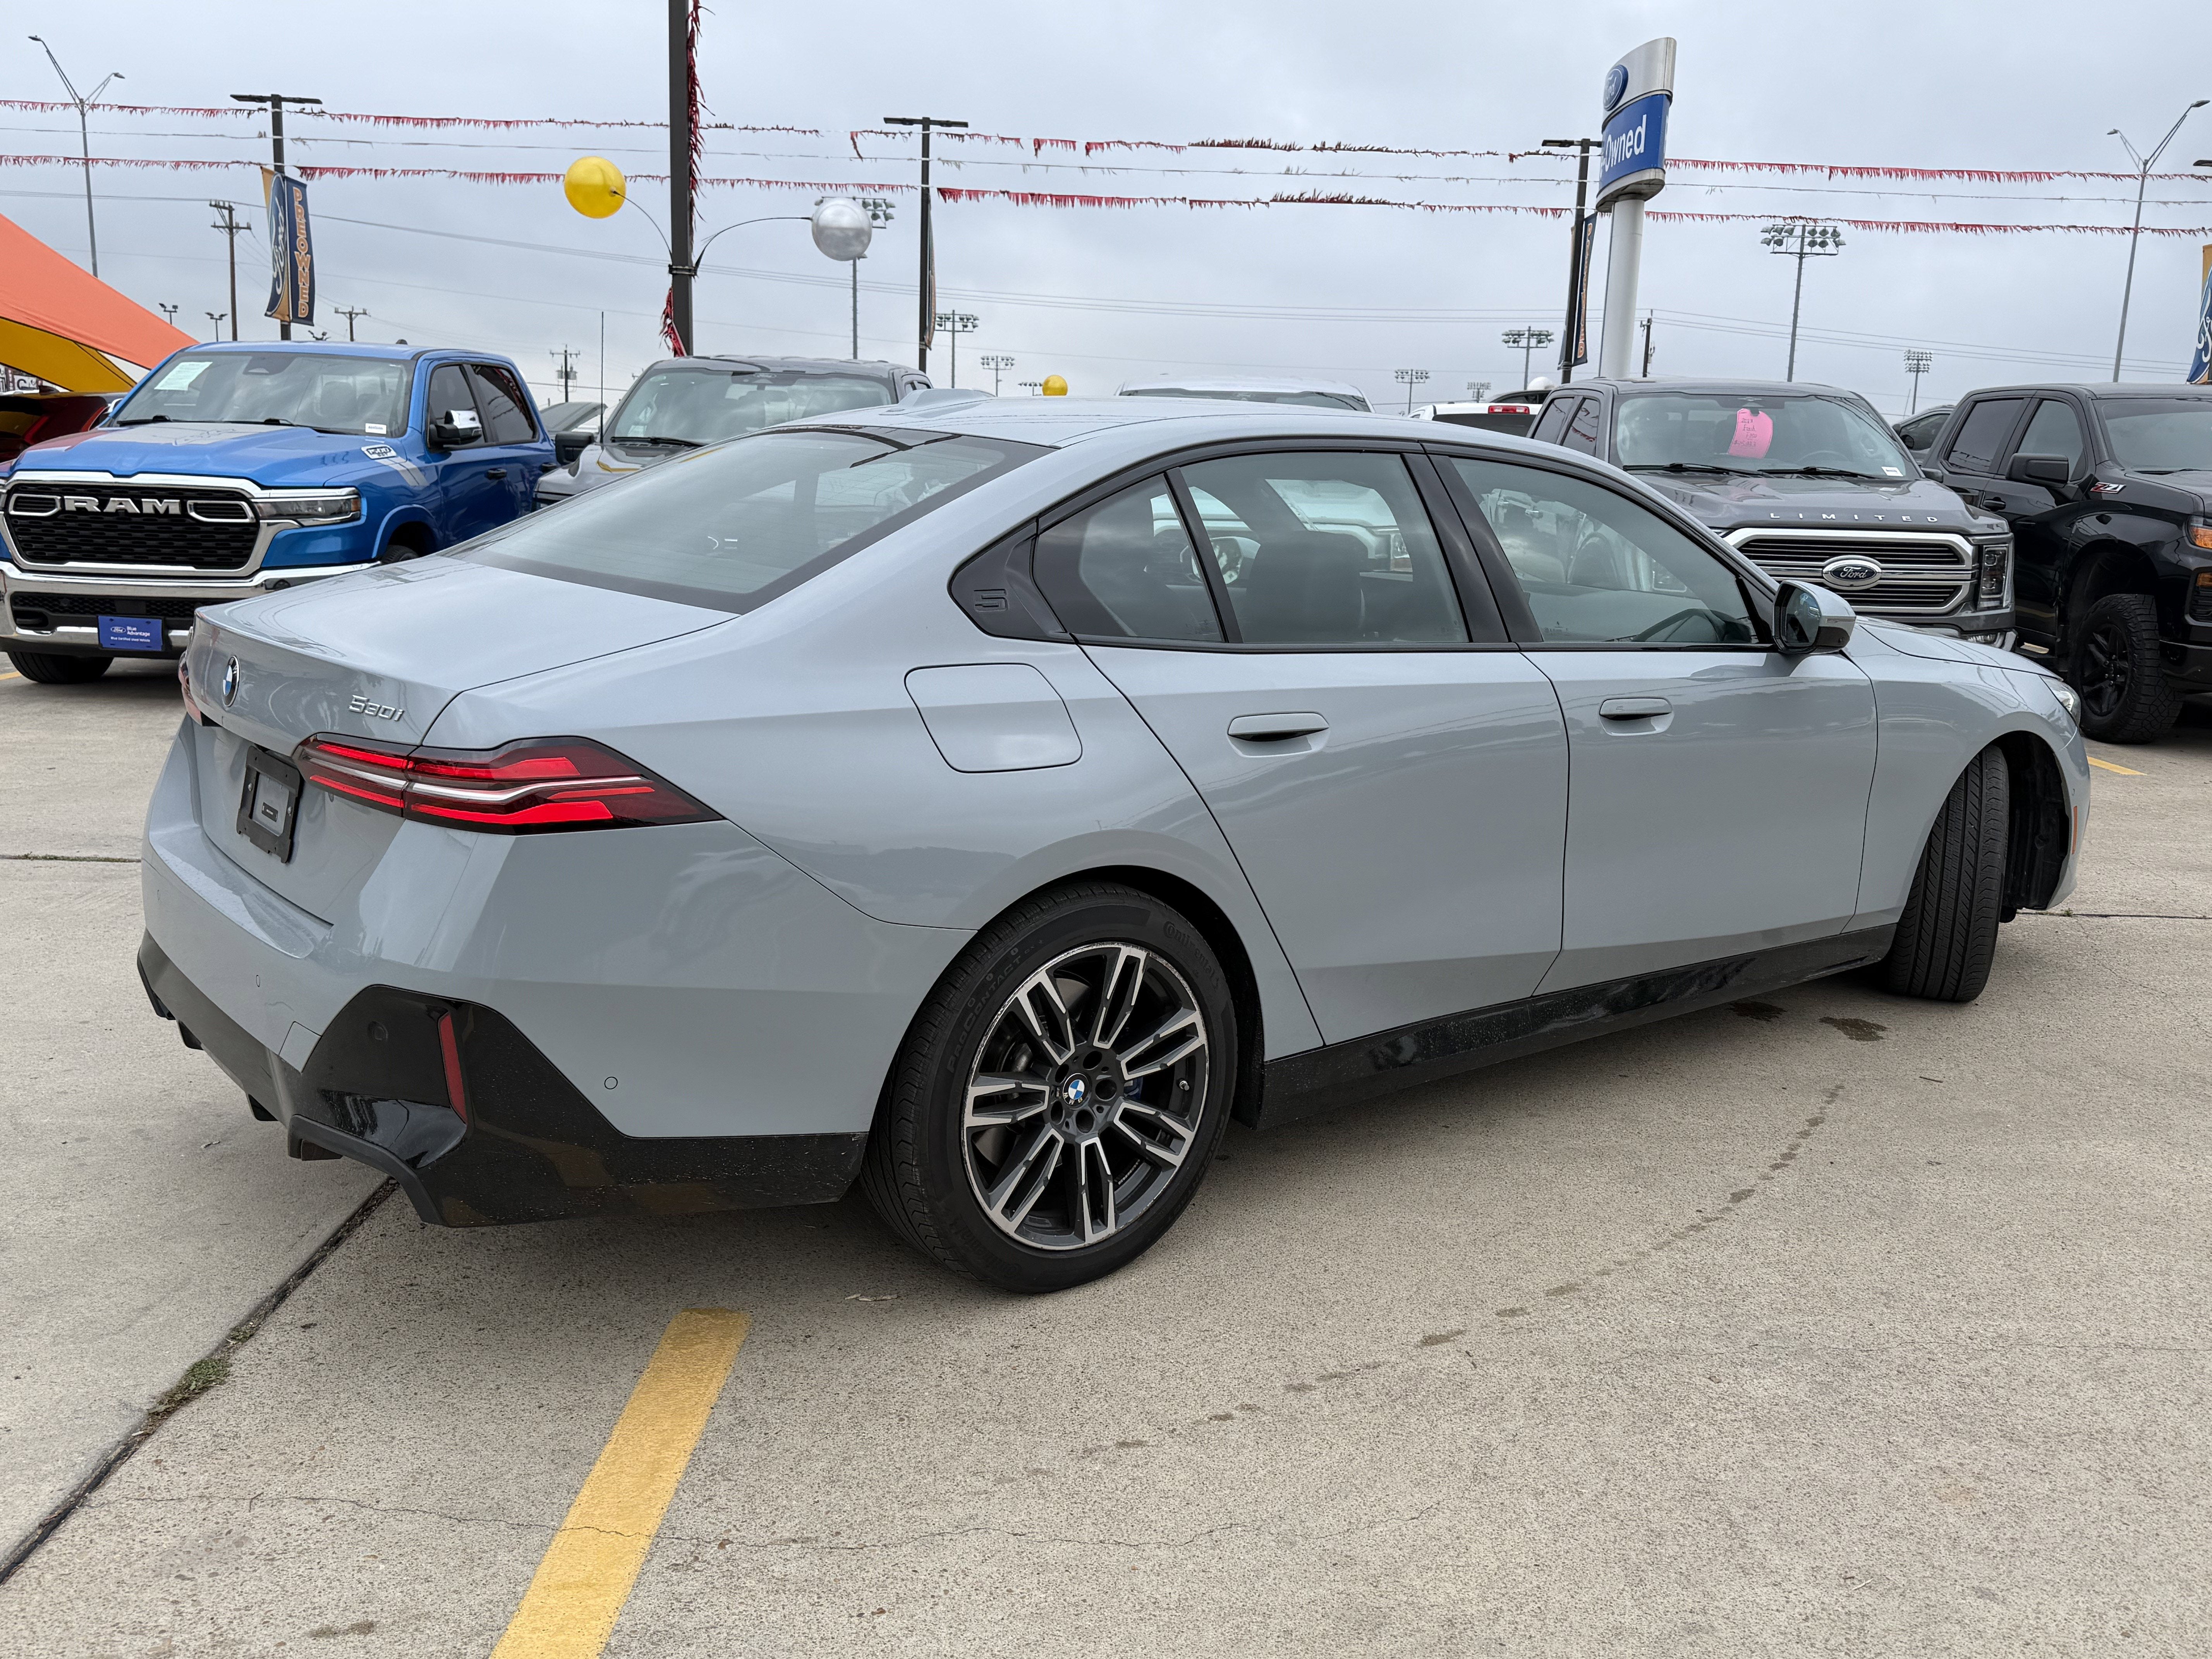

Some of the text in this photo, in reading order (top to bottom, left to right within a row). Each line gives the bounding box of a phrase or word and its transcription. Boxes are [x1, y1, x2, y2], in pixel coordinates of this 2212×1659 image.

[292, 186, 311, 318] PREOWNED
[2090, 482, 2126, 494] Z71
[64, 495, 182, 515] RAM
[1770, 513, 1938, 523] LIMITED
[1840, 566, 1869, 579] Ford
[349, 694, 404, 721] 530i
